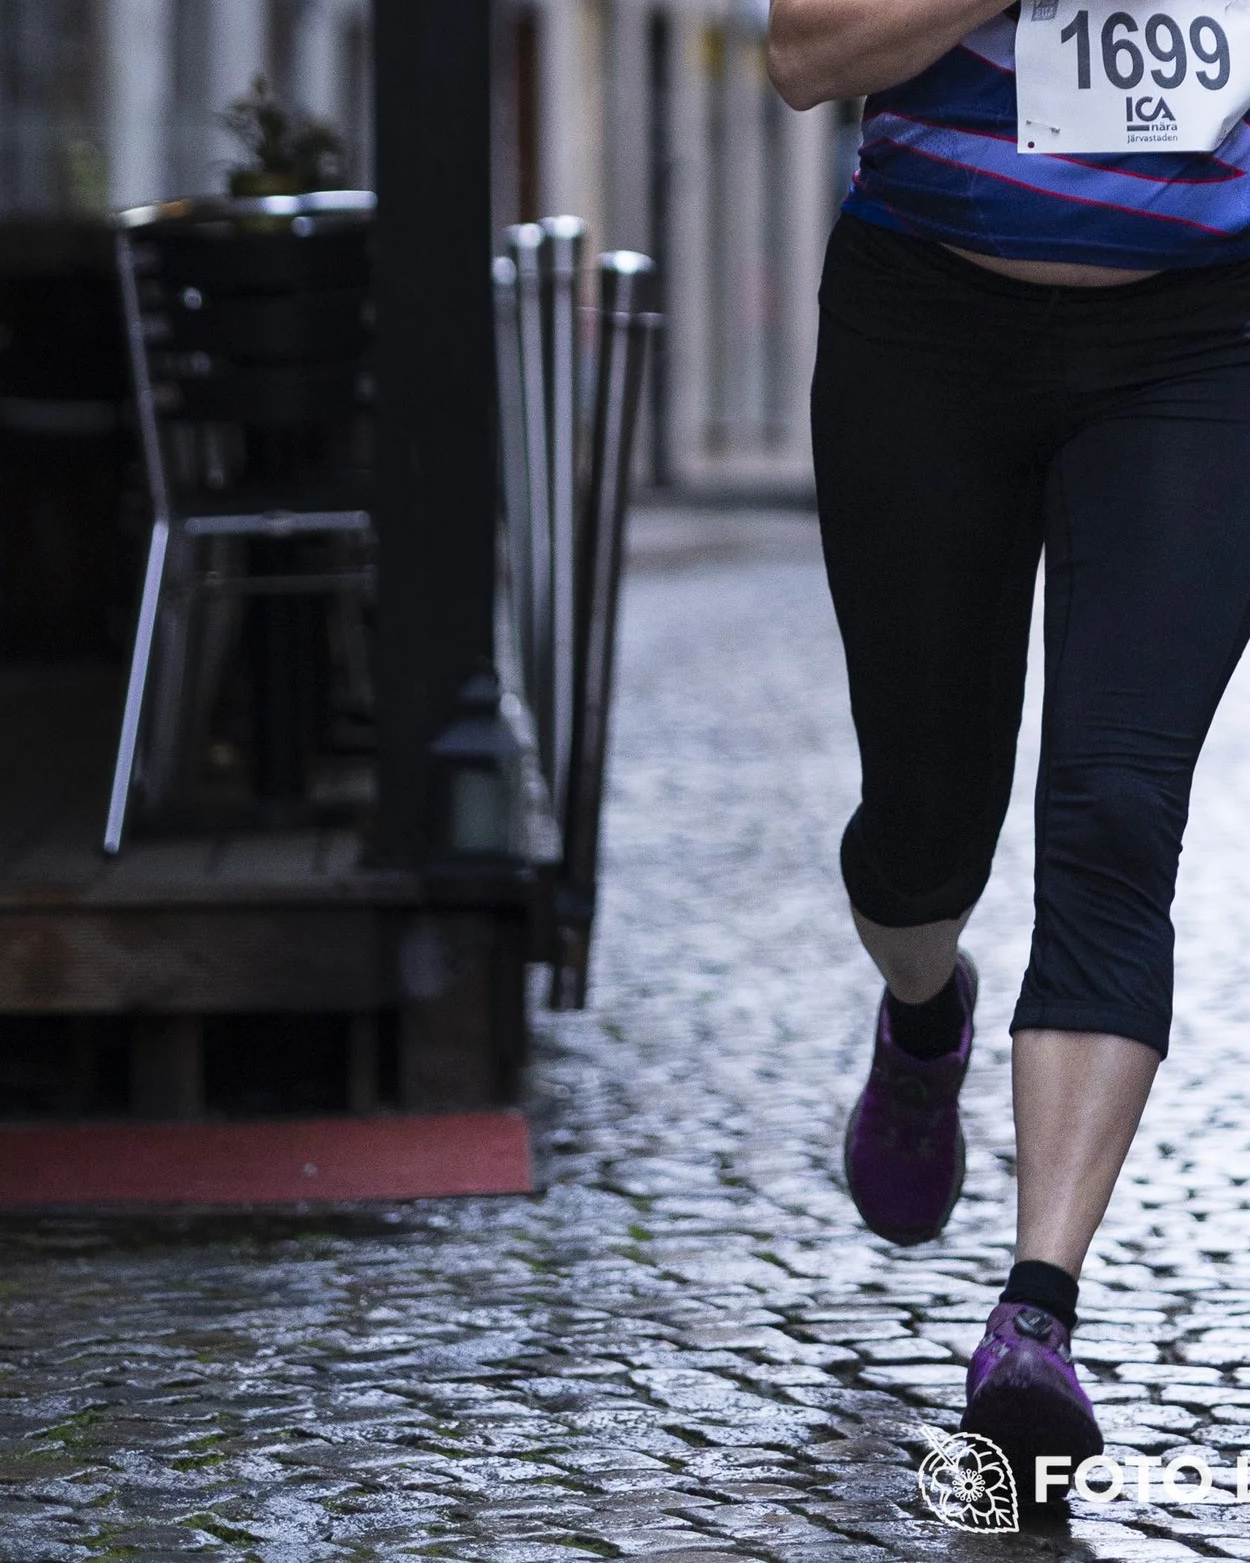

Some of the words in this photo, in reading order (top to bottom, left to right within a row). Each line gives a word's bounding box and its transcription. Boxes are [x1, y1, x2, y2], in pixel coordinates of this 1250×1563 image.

[1060, 9, 1231, 91] 1699
[1126, 96, 1176, 122] ICA
[1151, 122, 1178, 131] nära
